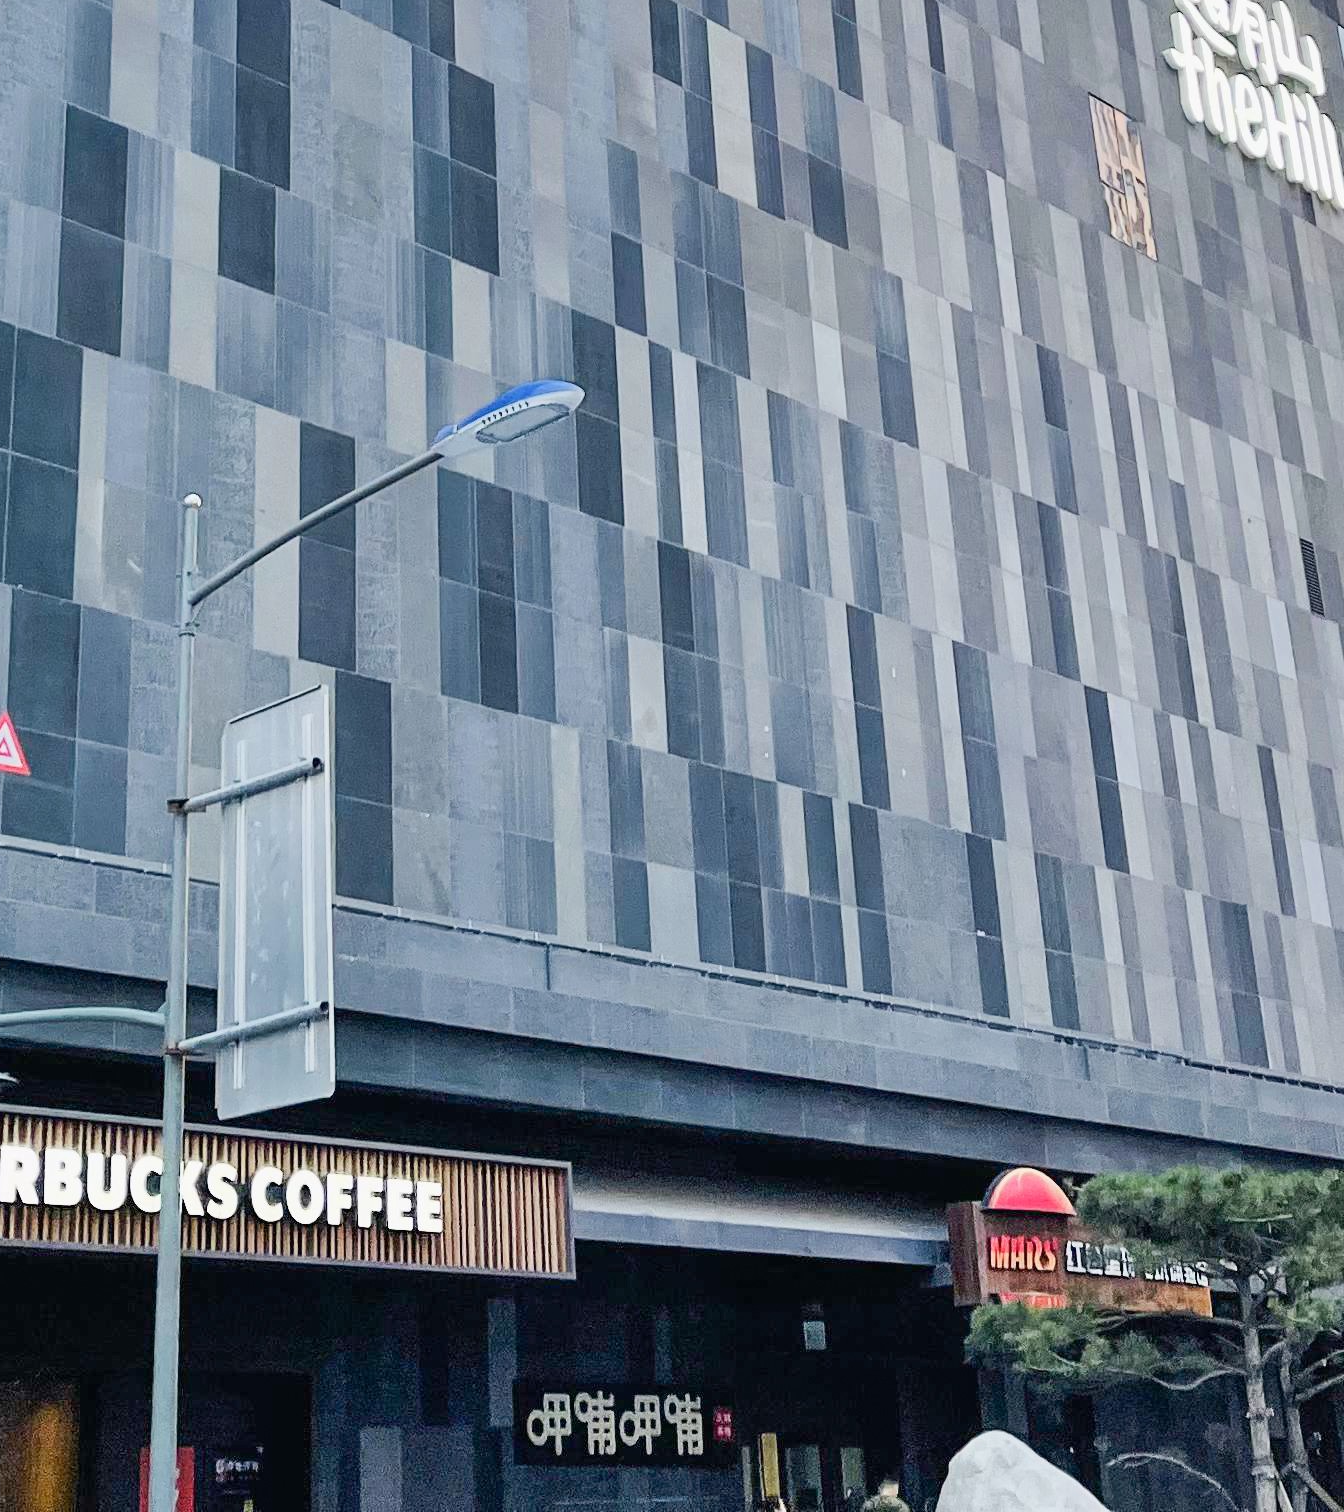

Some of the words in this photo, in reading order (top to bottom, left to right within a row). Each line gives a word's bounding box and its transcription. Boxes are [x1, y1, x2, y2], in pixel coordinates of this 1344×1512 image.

[250, 1163, 443, 1235] COFFEE
[989, 1233, 1057, 1272] MARS
[526, 1390, 704, 1456] 呷哺呷哺
